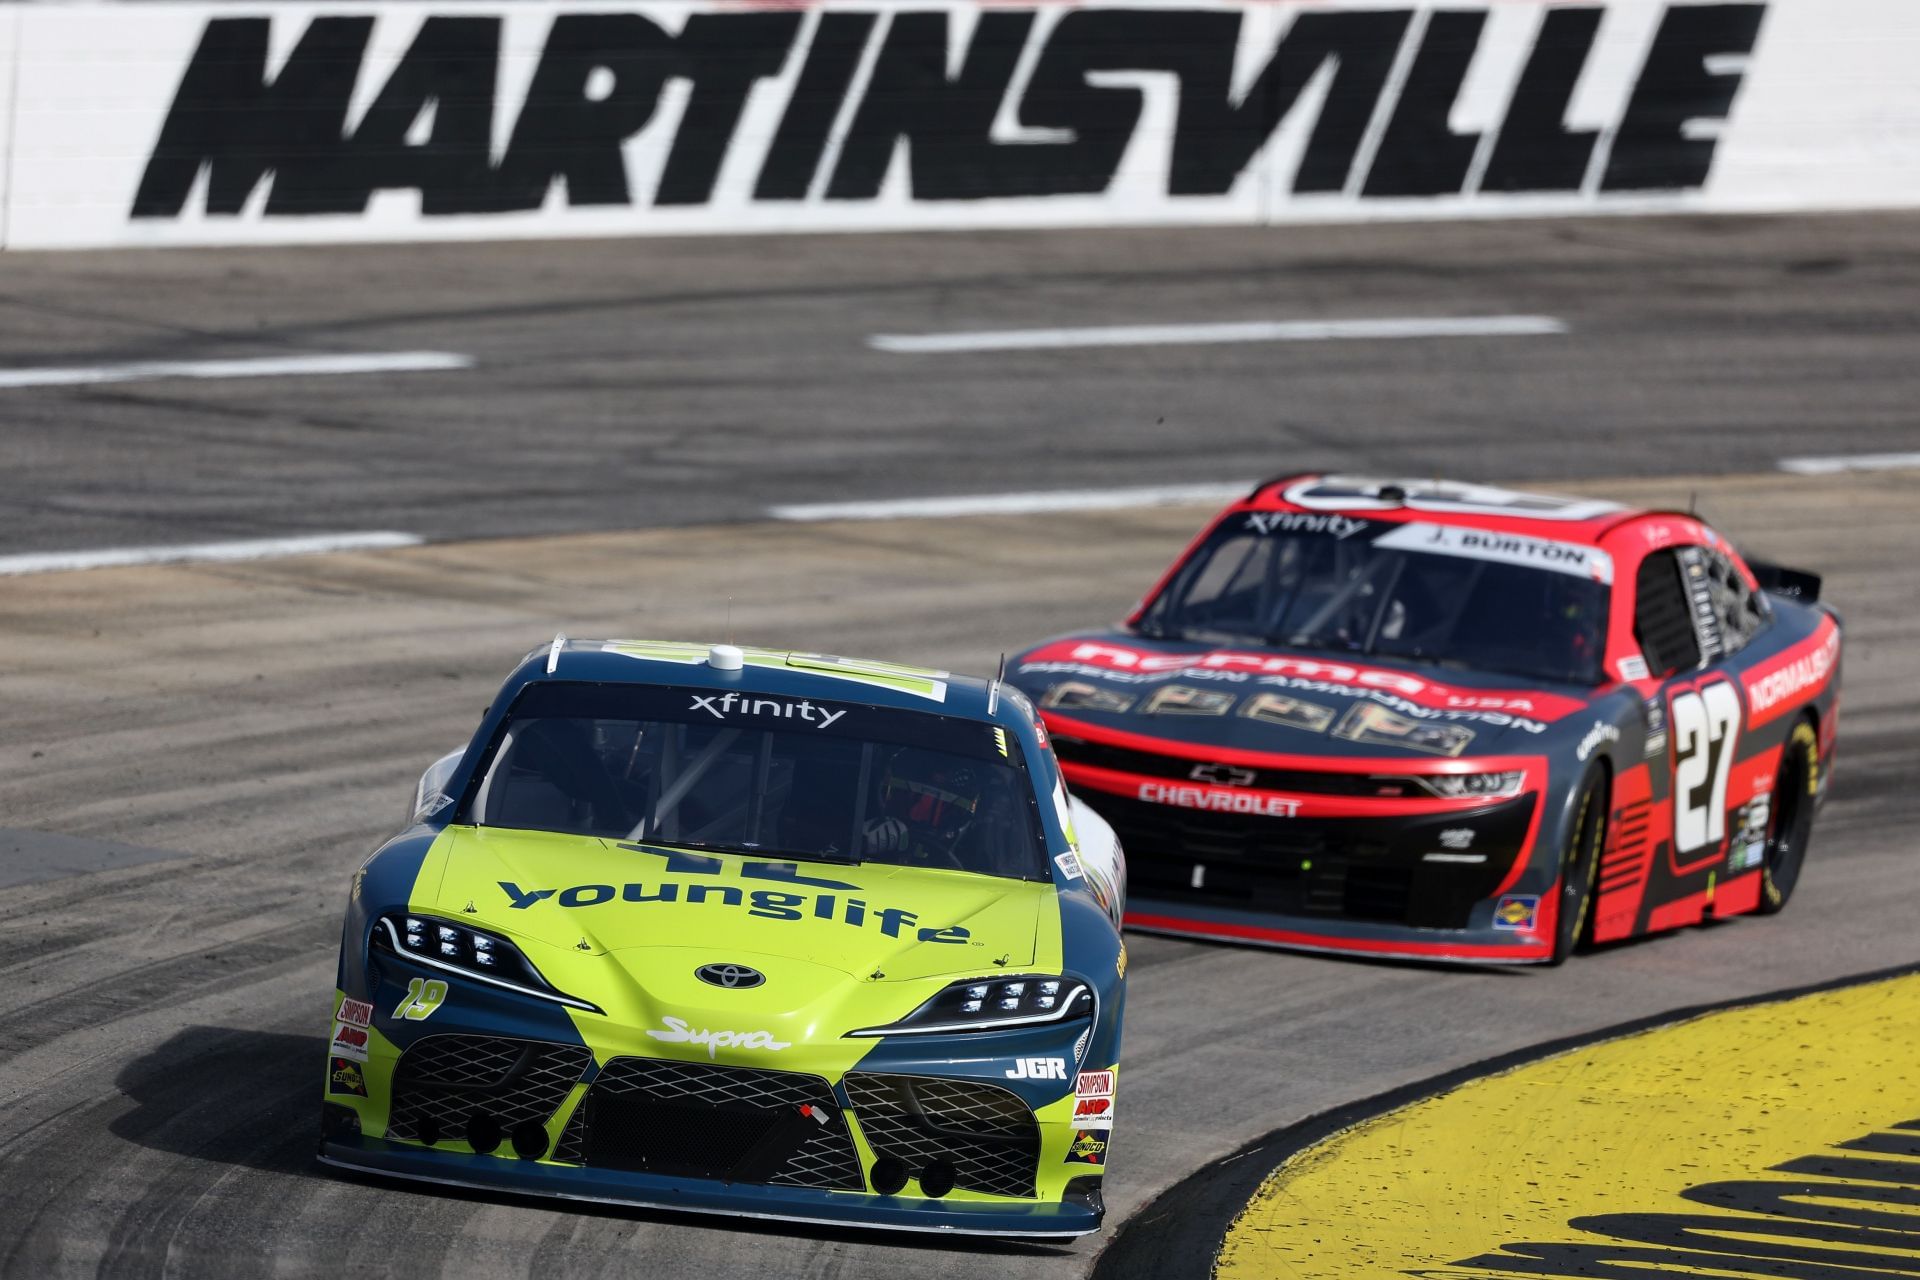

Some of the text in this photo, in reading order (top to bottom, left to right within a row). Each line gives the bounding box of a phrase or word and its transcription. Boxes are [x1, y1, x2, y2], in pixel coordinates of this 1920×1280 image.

[129, 2, 1769, 220] MARTINSVILLE
[1245, 510, 1367, 540] xfinity
[1427, 526, 1587, 566] J. BURTON
[688, 692, 847, 729] xfinity
[1448, 695, 1533, 712] USA
[1672, 681, 1742, 854] 27
[1138, 783, 1303, 818] CHEVROLET
[497, 881, 971, 945] younglife
[342, 1001, 370, 1025] SIMPSON
[391, 977, 449, 1021] 19
[646, 1016, 791, 1059] Supra
[1005, 1058, 1067, 1079] JGR
[1078, 1074, 1109, 1094] SIMPSON
[1075, 1098, 1110, 1115] ARP
[1072, 1141, 1103, 1152] SUNOCO
